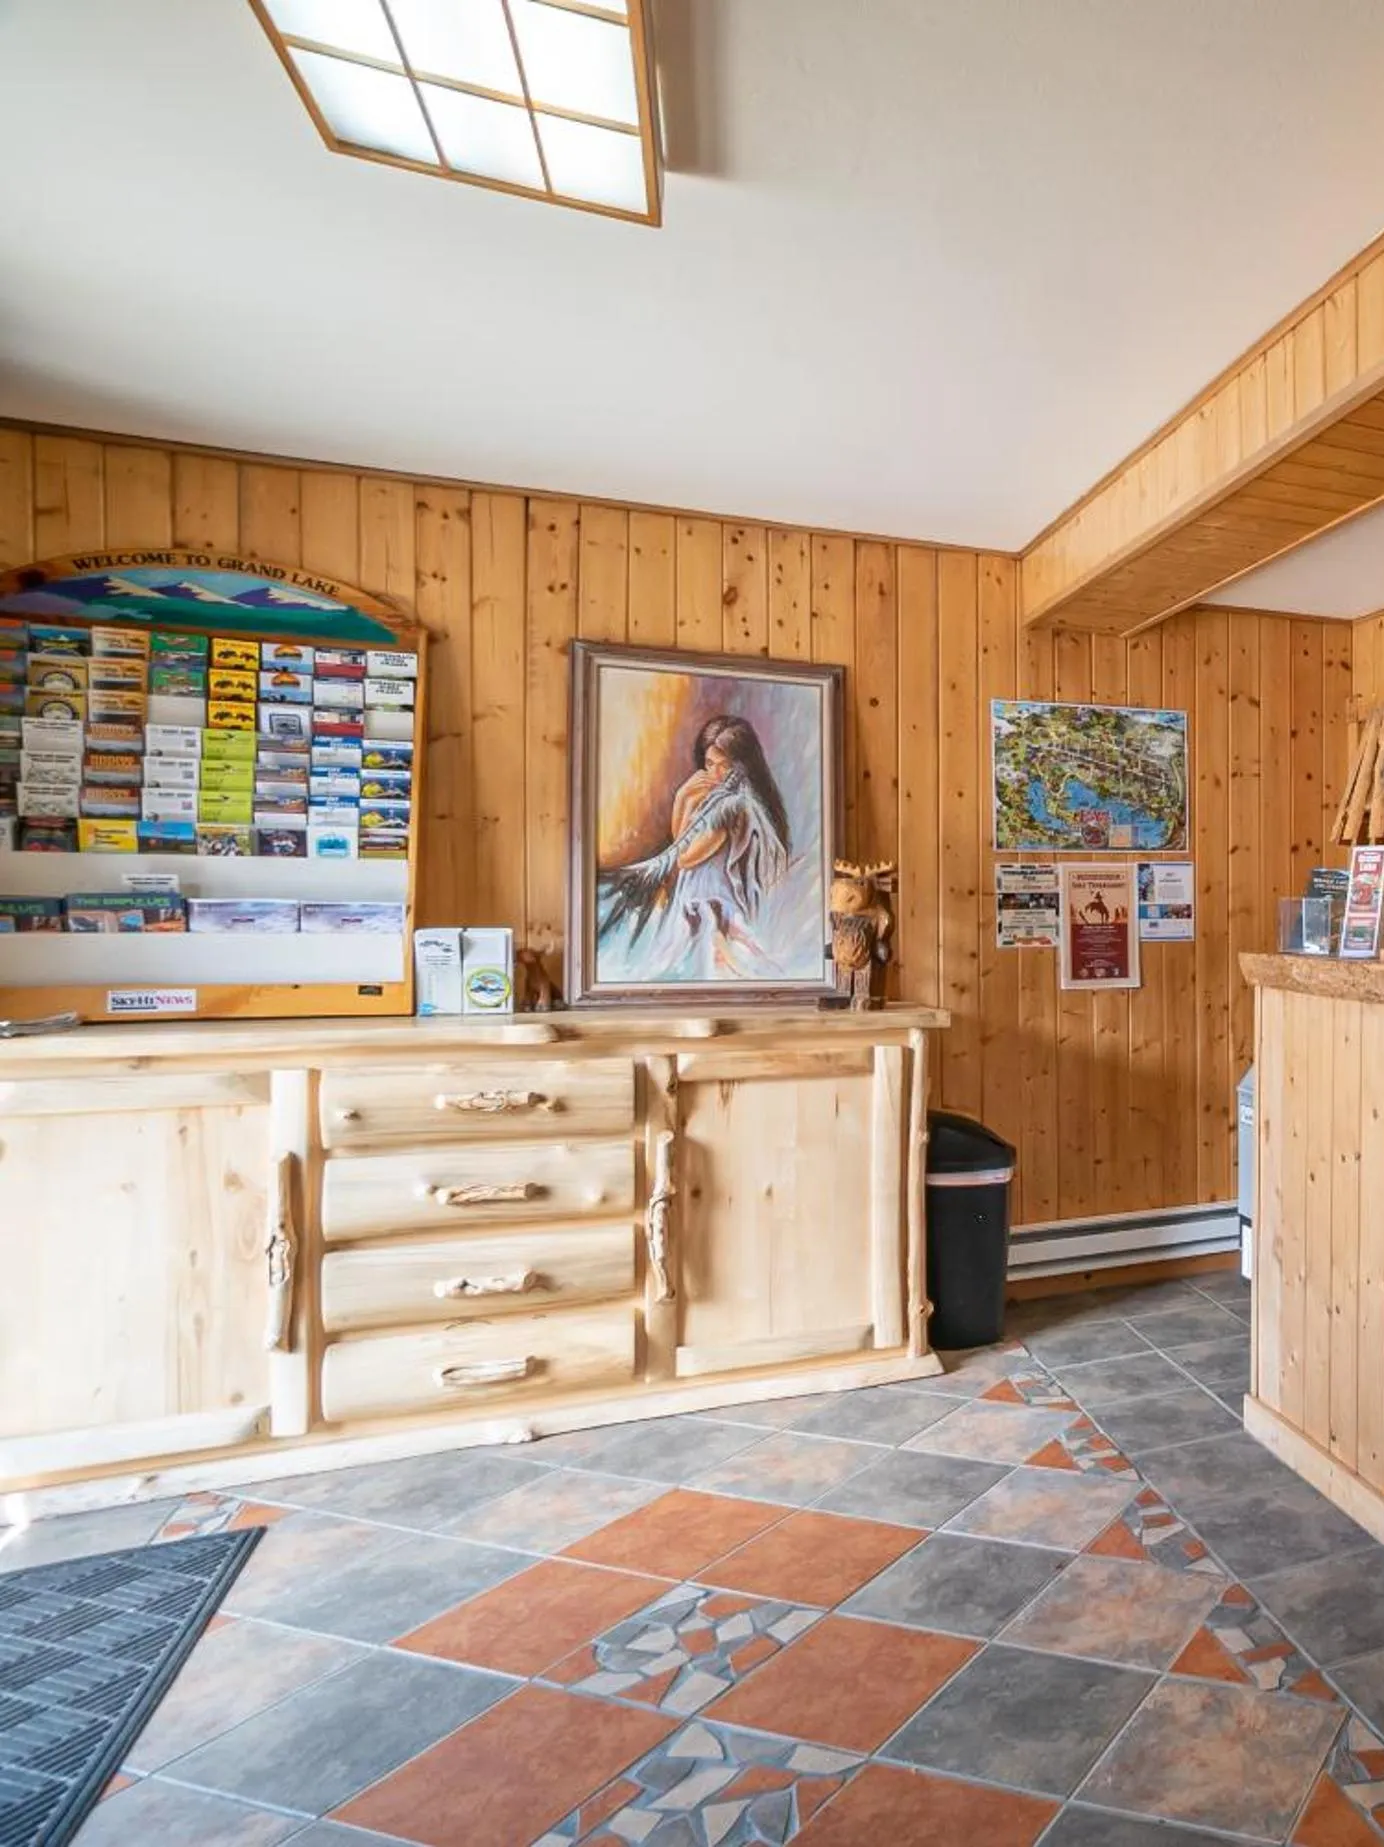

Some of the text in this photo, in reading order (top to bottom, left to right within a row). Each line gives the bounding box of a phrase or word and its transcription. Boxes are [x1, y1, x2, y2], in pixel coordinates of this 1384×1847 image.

[72, 552, 341, 597] WELCOME TO GRAND LAKE
